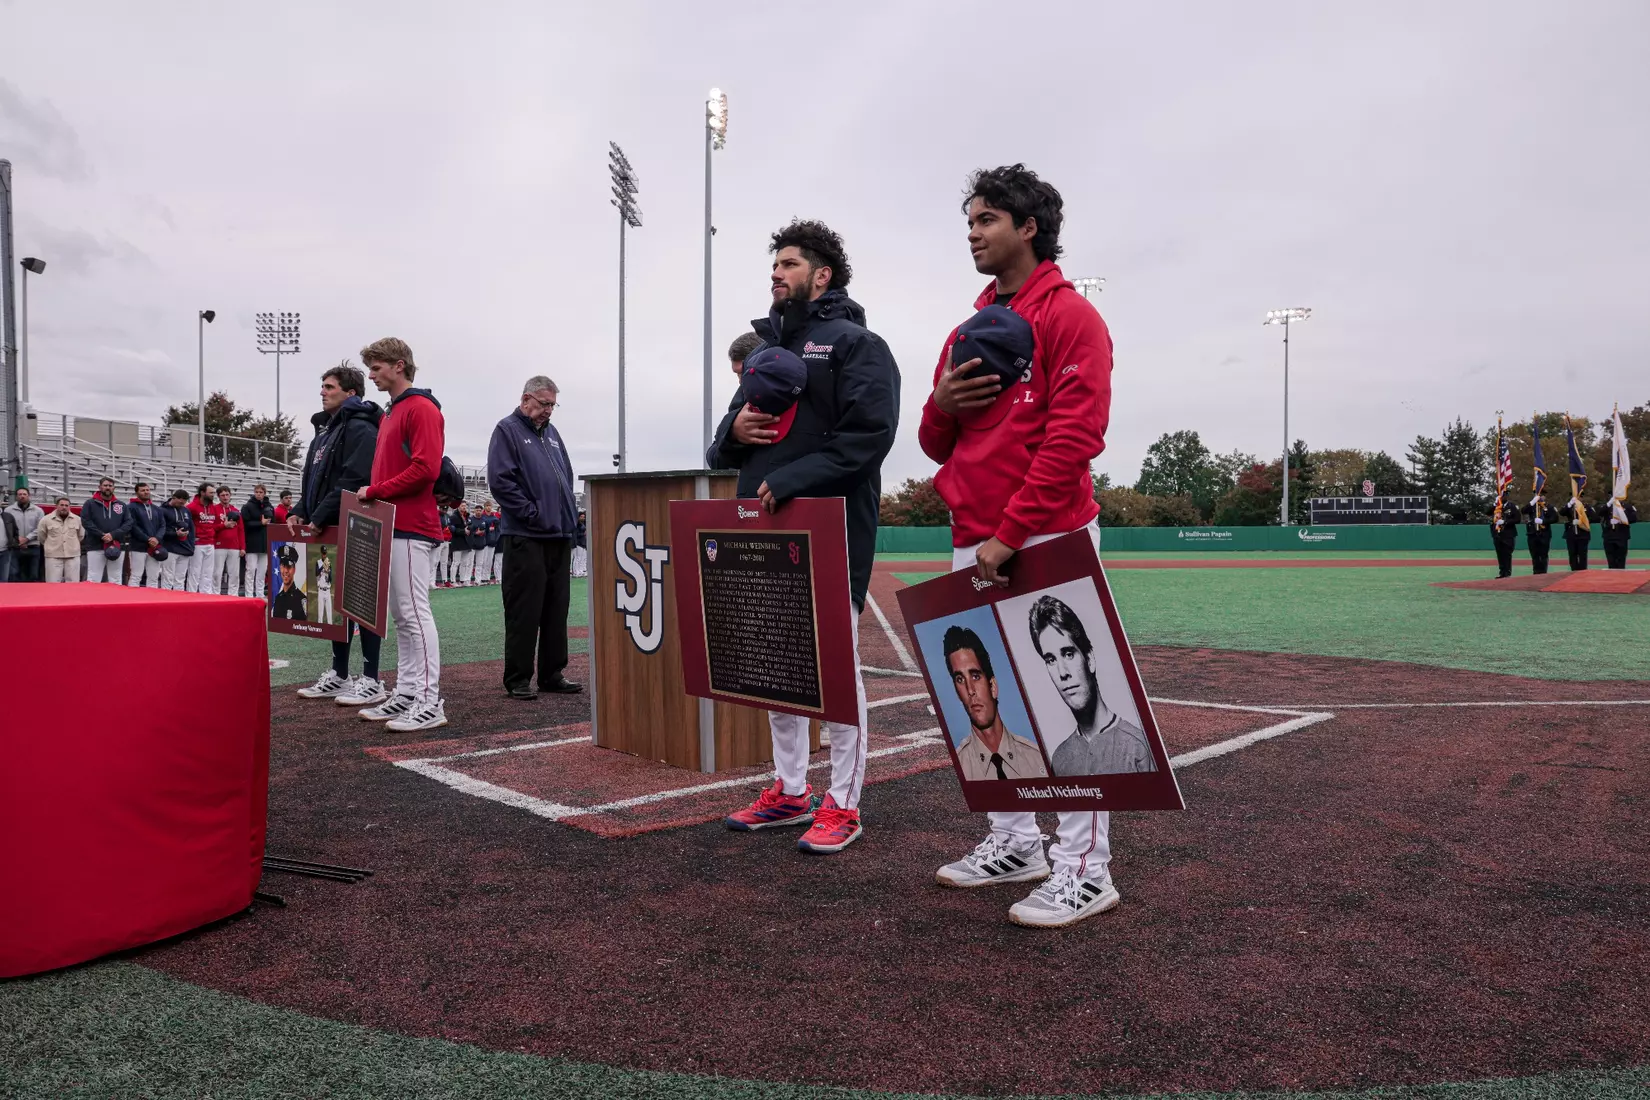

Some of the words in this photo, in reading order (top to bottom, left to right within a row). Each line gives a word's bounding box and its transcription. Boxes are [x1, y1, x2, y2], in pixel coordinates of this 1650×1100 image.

[724, 542, 748, 550] MICHAEL
[749, 542, 780, 550] WEINBERG
[739, 554, 765, 562] 1967-2001
[1016, 786, 1053, 798] Michael
[1052, 784, 1103, 800] Weinburg
